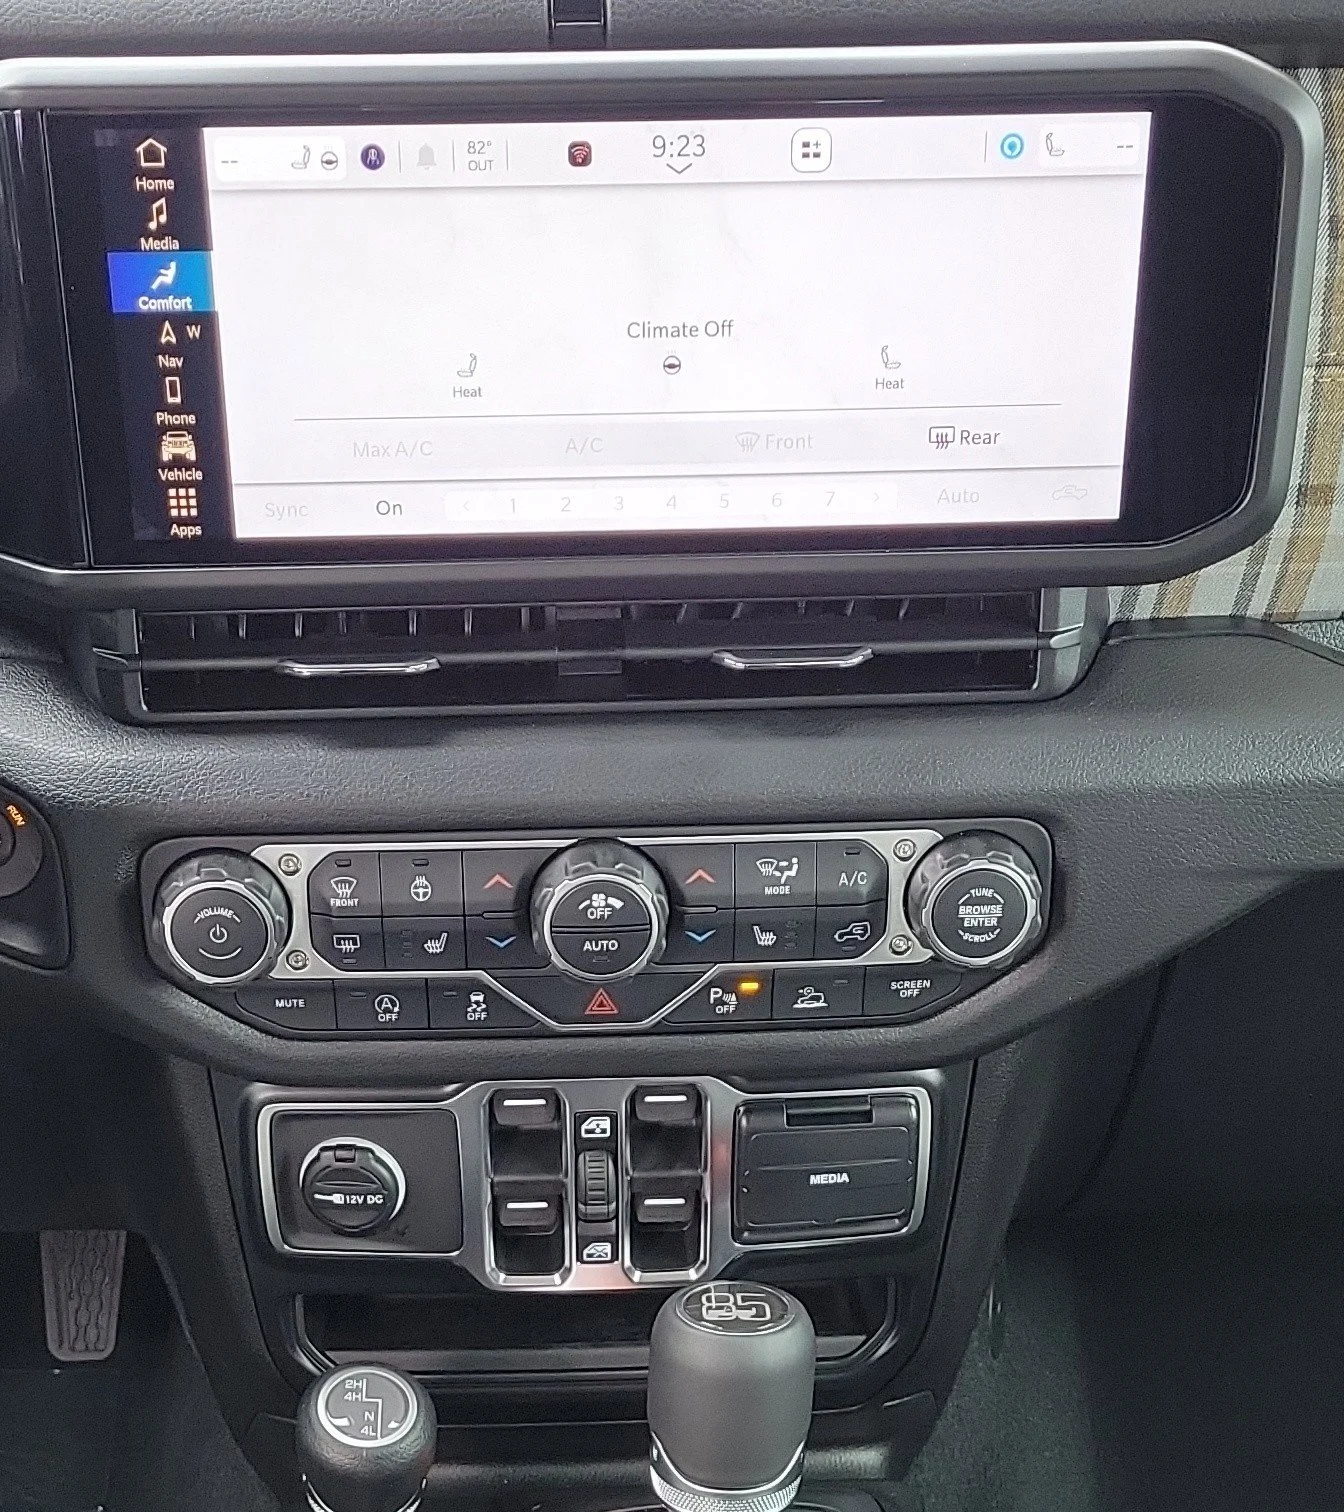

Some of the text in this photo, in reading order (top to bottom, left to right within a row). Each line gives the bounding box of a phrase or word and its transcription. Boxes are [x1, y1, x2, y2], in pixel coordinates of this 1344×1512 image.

[466, 139, 493, 156] 82°
[651, 133, 707, 159] 9:23
[467, 158, 495, 172] OUT
[135, 174, 175, 192] Home
[140, 235, 180, 252] Media
[138, 293, 194, 311] Comfort
[186, 324, 202, 340] W
[626, 318, 735, 339] Climate Off
[157, 352, 184, 369] Nav
[874, 375, 905, 390] Heat
[452, 384, 483, 399] Heat
[156, 409, 197, 427] Phone
[764, 432, 814, 451] Front
[959, 428, 1001, 447] Rear
[352, 438, 434, 459] Max A/C
[564, 436, 605, 454] A/C
[158, 466, 203, 483] Vehicle
[937, 488, 981, 505] Auto
[375, 500, 404, 518] On
[170, 522, 203, 539] Apps
[6, 804, 26, 828] RUN
[838, 870, 869, 888] A/C
[763, 884, 792, 896] MODE
[970, 887, 994, 899] TUNE
[329, 898, 360, 907] FRONT
[197, 908, 234, 919] VOLUME
[586, 907, 613, 920] OFF
[957, 904, 1003, 916] BROWSE
[963, 916, 999, 927] ENTER
[961, 930, 997, 943] SCROLL
[582, 939, 619, 952] AUTO
[890, 979, 932, 992] SCREEN
[899, 989, 921, 998] OFF
[274, 997, 306, 1009] MUTE
[715, 1005, 737, 1014] OFF
[377, 1012, 400, 1022] OFF
[466, 1011, 489, 1021] OFF
[809, 1172, 850, 1185] MEDIA
[345, 1194, 384, 1205] 12V DC
[344, 1379, 363, 1389] 2H
[343, 1391, 362, 1402] 4H
[364, 1411, 375, 1421] N
[360, 1425, 377, 1436] 4L
